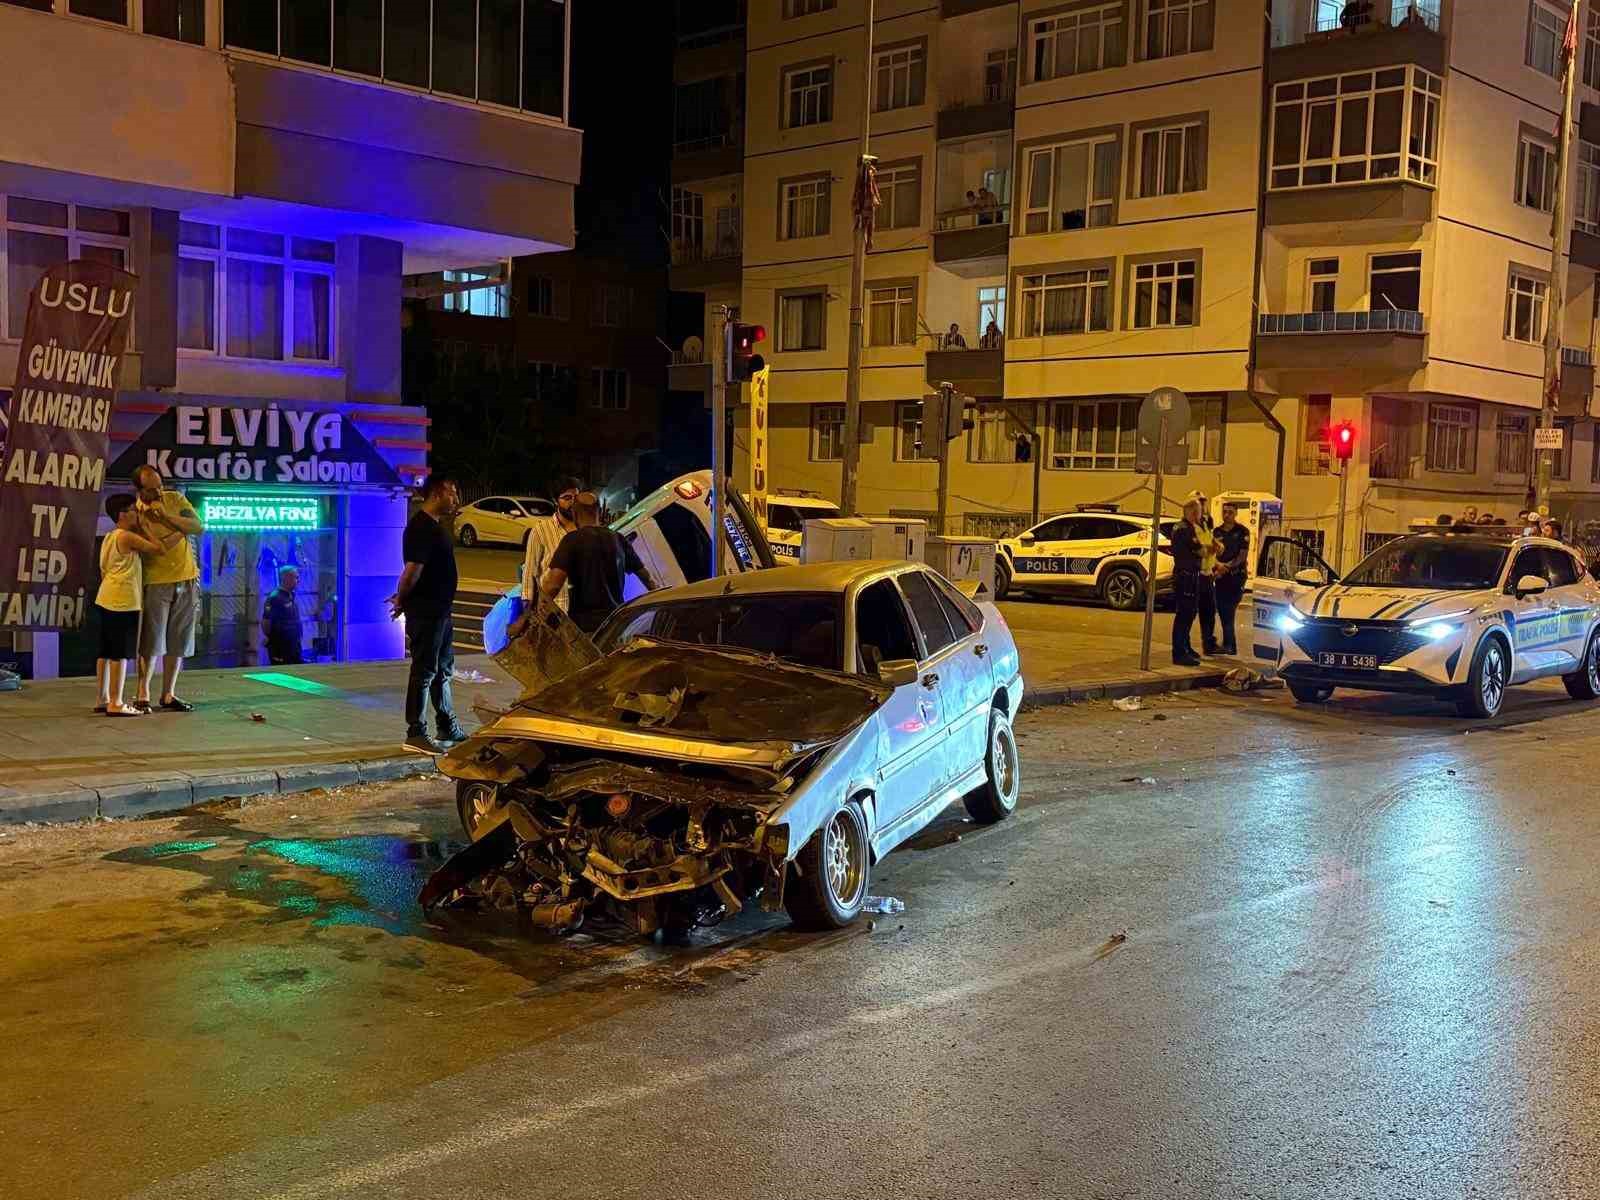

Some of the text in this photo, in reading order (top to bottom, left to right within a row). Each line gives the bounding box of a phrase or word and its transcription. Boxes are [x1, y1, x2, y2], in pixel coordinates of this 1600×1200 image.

[40, 277, 130, 318] USLU
[28, 338, 117, 389] GÜVENLİK
[18, 388, 110, 433] KAMERASI
[176, 403, 342, 452] ELVİYA
[5, 448, 103, 492] ALARM
[146, 449, 367, 482] Kuaför Salonu
[31, 504, 67, 538] TV
[17, 547, 68, 583] LED
[771, 543, 793, 556] POLİS
[1026, 559, 1059, 572] POLİS
[1324, 654, 1335, 665] 38
